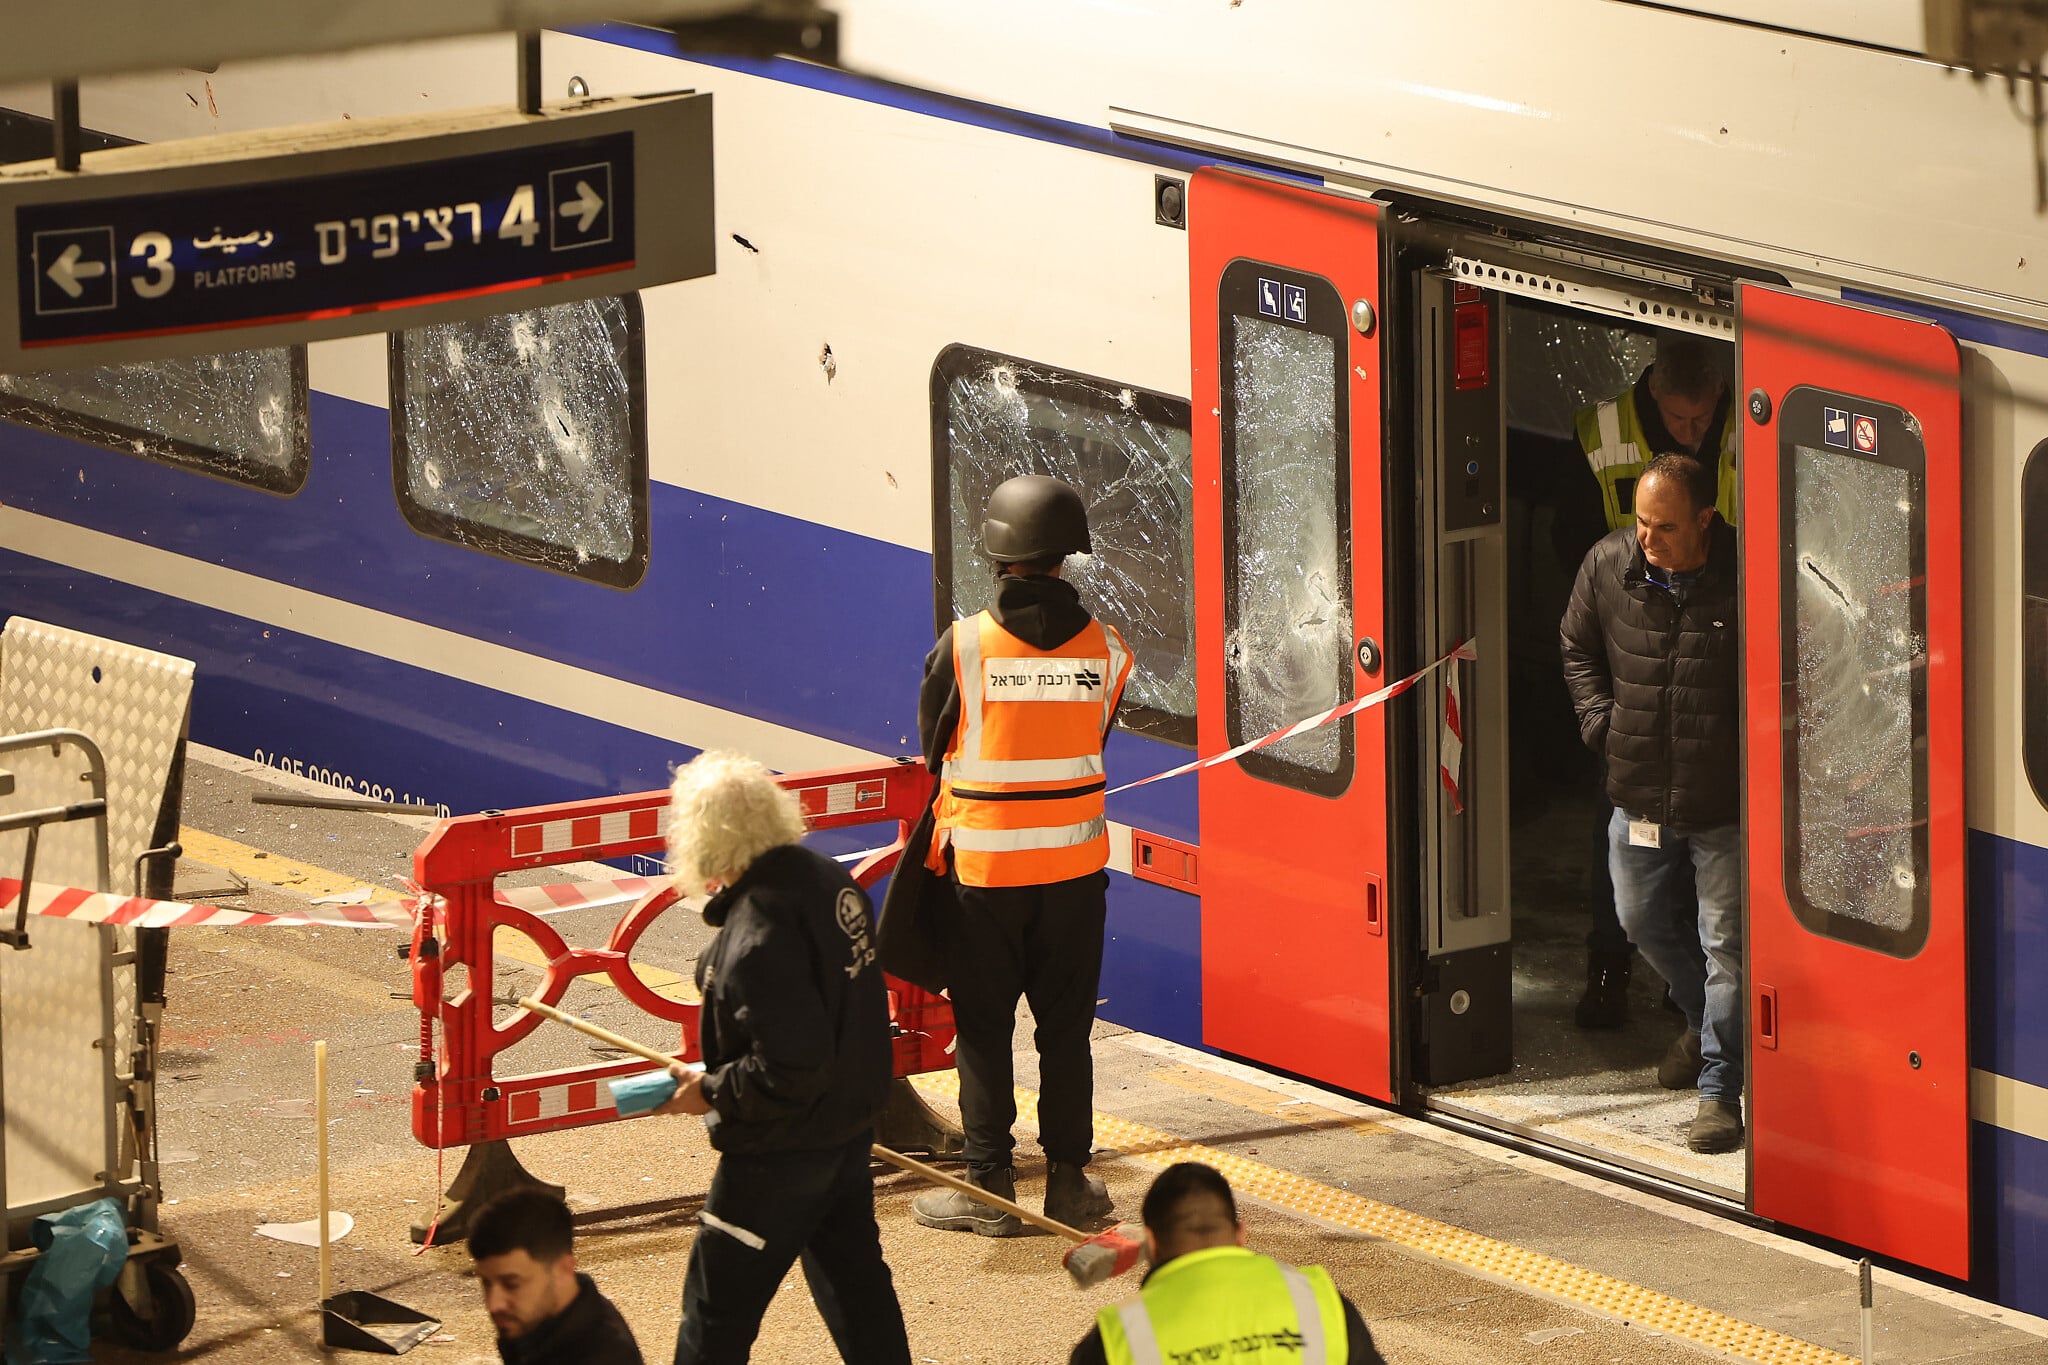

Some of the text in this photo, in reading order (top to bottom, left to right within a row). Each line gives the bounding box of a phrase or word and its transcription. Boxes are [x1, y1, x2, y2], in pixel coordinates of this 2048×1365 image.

[314, 184, 540, 265] רציפים 4
[129, 225, 274, 298] 3 رصيف
[194, 260, 296, 288] PLATFORMS
[990, 673, 1071, 687] רכבת ישראל
